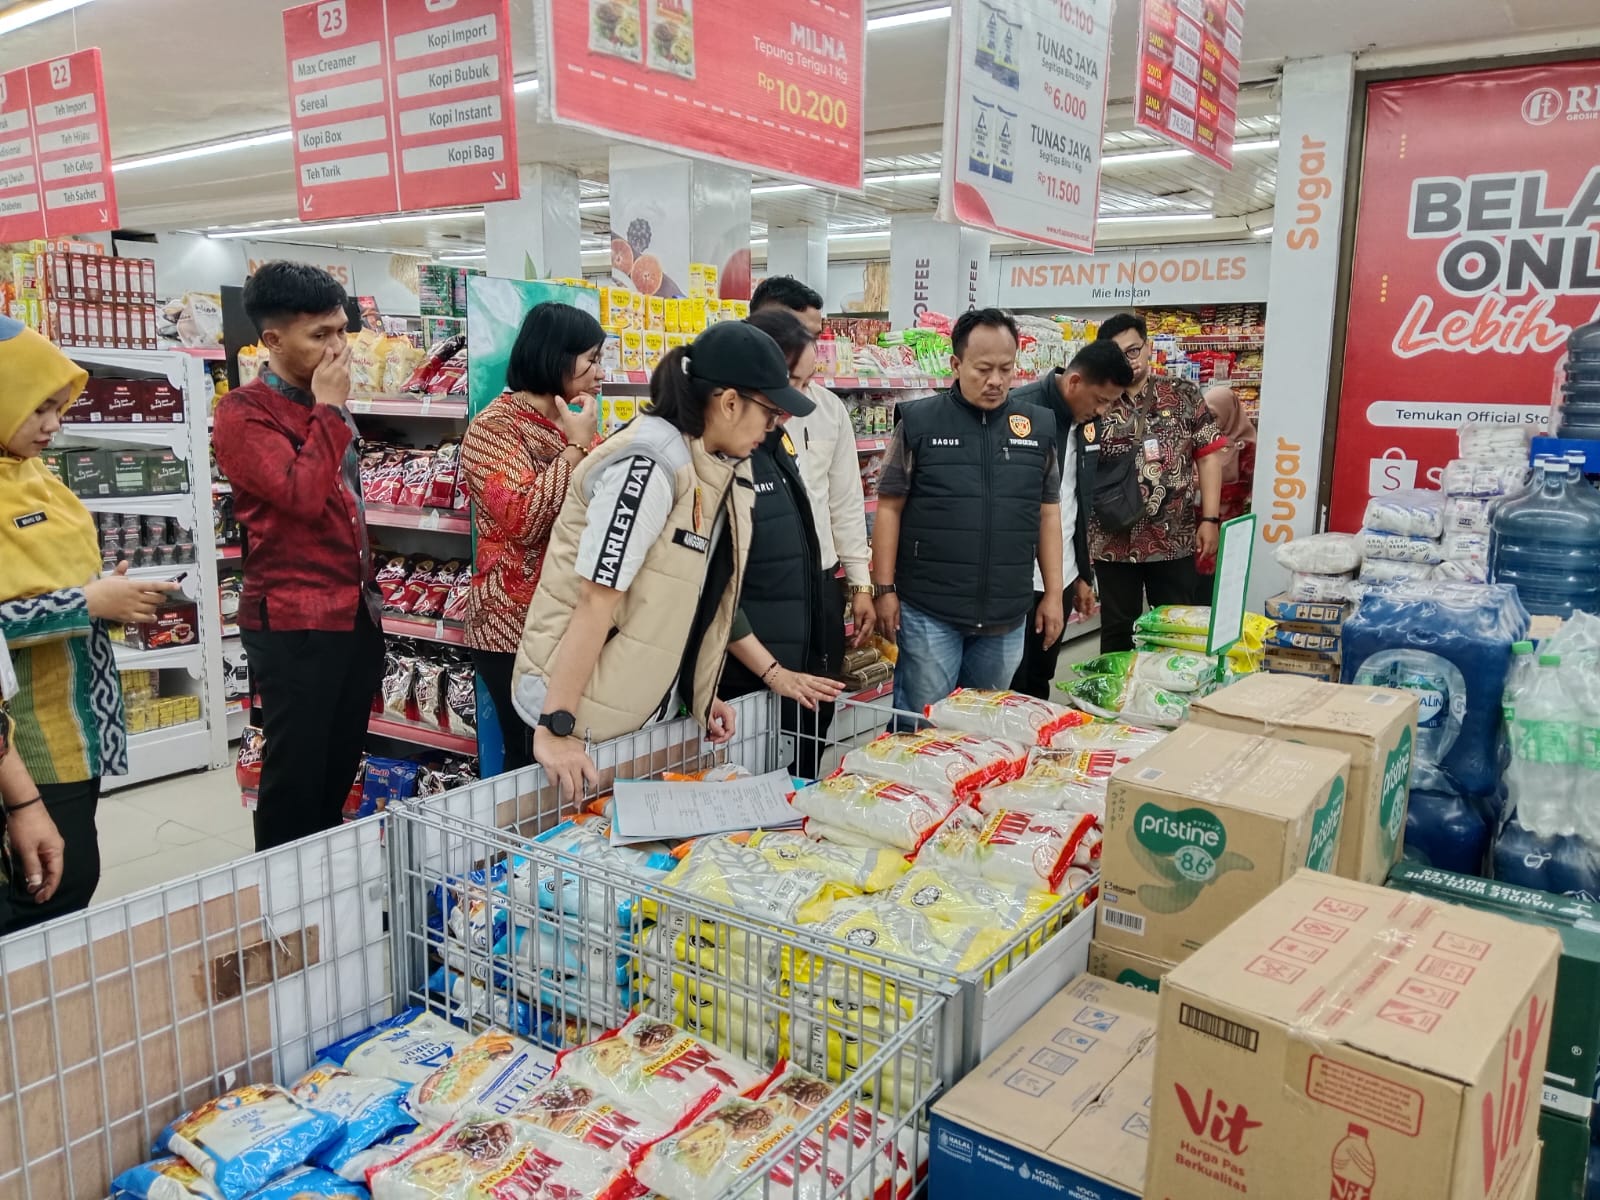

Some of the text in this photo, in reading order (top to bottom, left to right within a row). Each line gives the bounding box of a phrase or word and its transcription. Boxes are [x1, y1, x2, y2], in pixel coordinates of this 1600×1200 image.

[323, 9, 343, 33] 23
[428, 23, 488, 49] Kopi Import
[298, 55, 356, 77] Max Creamer
[753, 35, 794, 66] Tepung
[795, 51, 828, 77] Terigu
[835, 65, 848, 85] Kg
[1036, 31, 1098, 81] TUNAS JAYA
[53, 64, 68, 86] 22
[428, 64, 490, 89] Kopi Bubuk
[54, 101, 88, 116] Teh Import
[300, 95, 328, 112] Sereal
[758, 72, 847, 129] Rp 10.200
[1044, 81, 1087, 121] Rp 6.000
[429, 104, 493, 128] Kopi Instant
[61, 130, 91, 145] Teh Hijau
[303, 129, 343, 149] Kopi Box
[1031, 123, 1092, 164] TUNAS JAYA
[64, 160, 94, 174] Teh Celup
[448, 144, 495, 165] Kopi Bag
[306, 165, 341, 181] Teh Tarik
[64, 188, 97, 203] Teh Sachet
[1037, 171, 1081, 205] Rp 11.500
[1286, 134, 1332, 250] Sugar
[1010, 257, 1247, 288] INSTANT NOODLES
[913, 258, 930, 328] OFFEE
[1092, 286, 1152, 300] Mie Instan
[1397, 296, 1568, 353] Lebih
[1396, 408, 1462, 422] Temukan
[1466, 409, 1520, 424] Official
[932, 438, 960, 447] BAGUS
[1263, 436, 1306, 543] Sugar
[596, 501, 635, 588] HARLEY
[1141, 815, 1220, 847] pristine
[1404, 871, 1555, 910] HANDLE WITH CARE
[1422, 869, 1543, 902] GLASS BOTTLES
[495, 1060, 555, 1116] TULIP
[1481, 994, 1549, 1198] Vit
[1174, 1081, 1264, 1156] Vit
[949, 1136, 971, 1150] HALAL
[988, 1147, 1011, 1162] Mineral
[1179, 1140, 1246, 1178] Harga Pas
[1031, 1174, 1061, 1191] MURNI
[1175, 1153, 1249, 1194] Berkualitas
